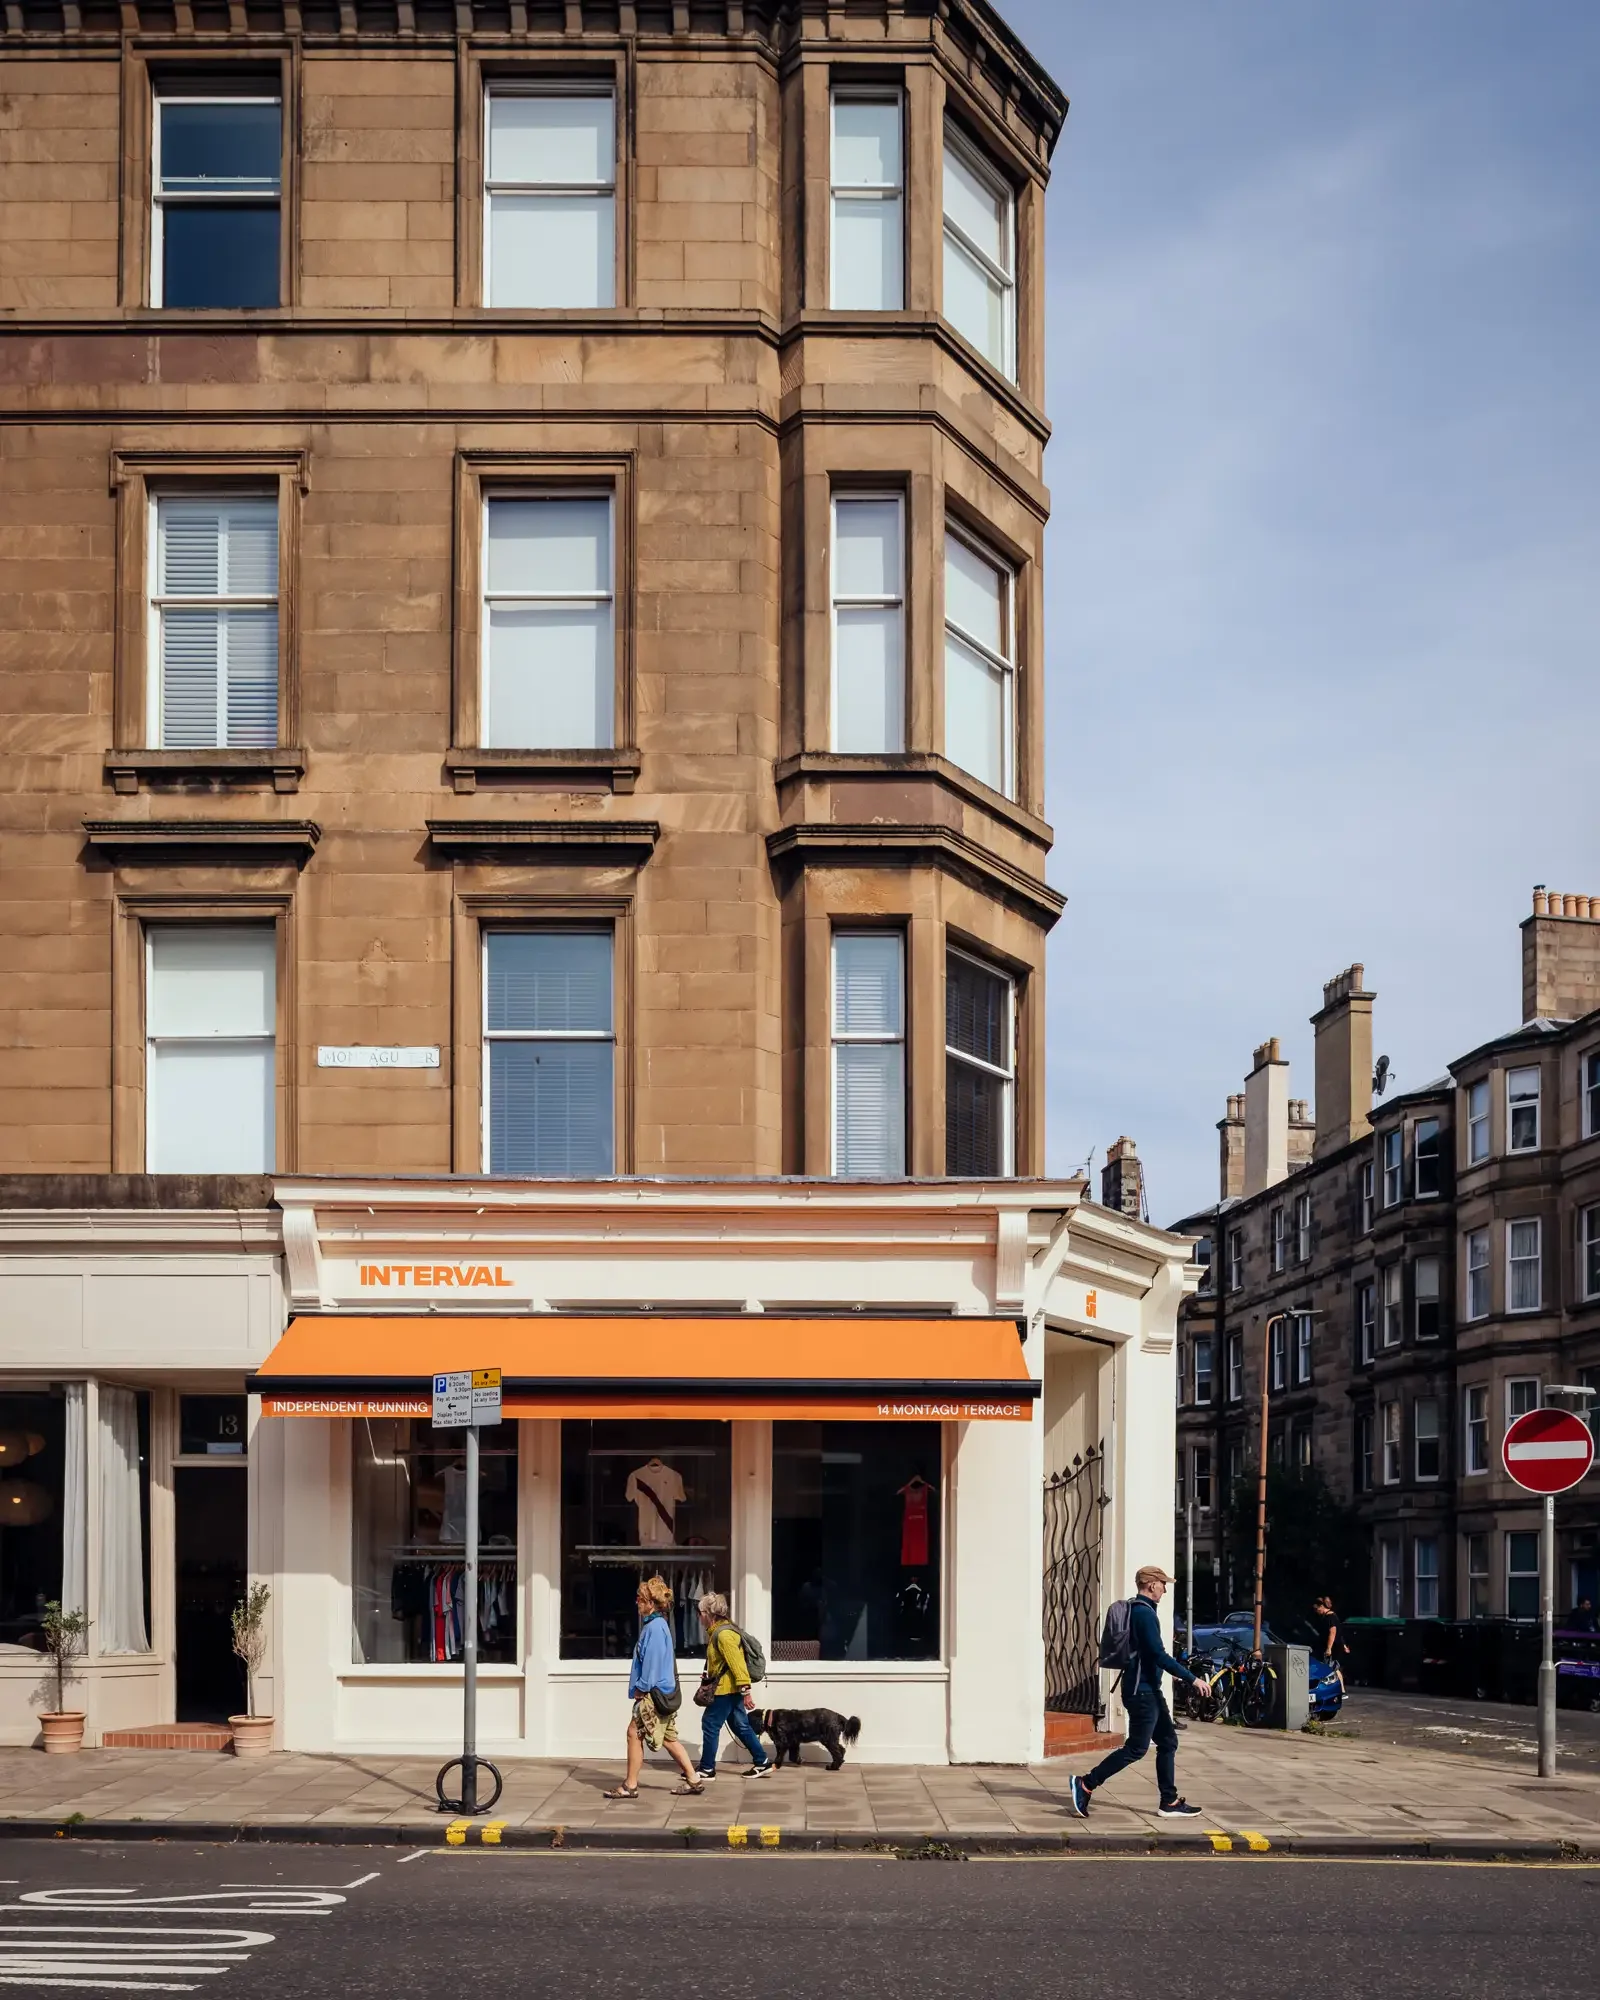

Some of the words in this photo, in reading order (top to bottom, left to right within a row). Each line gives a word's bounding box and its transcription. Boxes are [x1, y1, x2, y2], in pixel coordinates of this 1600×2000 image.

[360, 1265, 515, 1287] INTERVAL
[273, 1401, 364, 1412] INDEPENDENT
[368, 1401, 428, 1413] RUNNING
[876, 1404, 890, 1415] 14
[893, 1404, 959, 1416] MONTAGU
[962, 1405, 1021, 1416] TERRACE
[218, 1414, 239, 1436] 13
